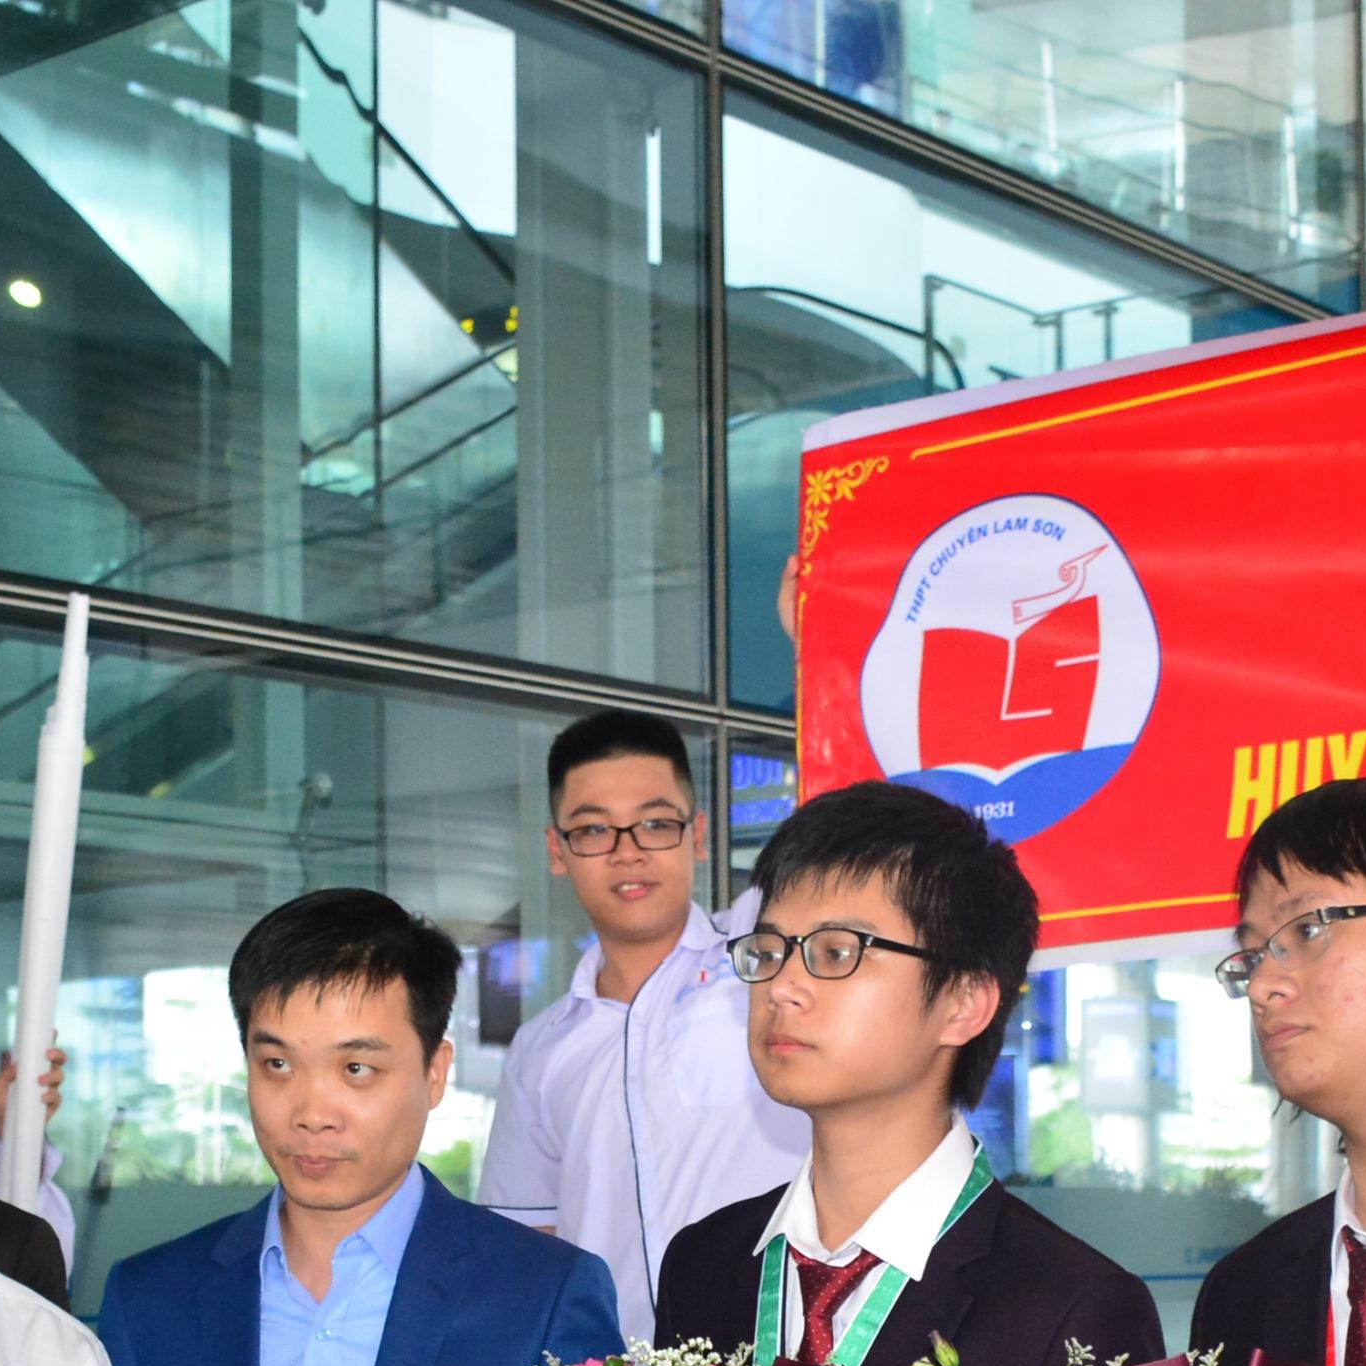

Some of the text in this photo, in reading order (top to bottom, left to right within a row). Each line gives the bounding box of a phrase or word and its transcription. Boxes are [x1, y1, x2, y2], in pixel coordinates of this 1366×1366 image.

[905, 517, 1066, 623] THPT CHUYÊN LAM SƠN
